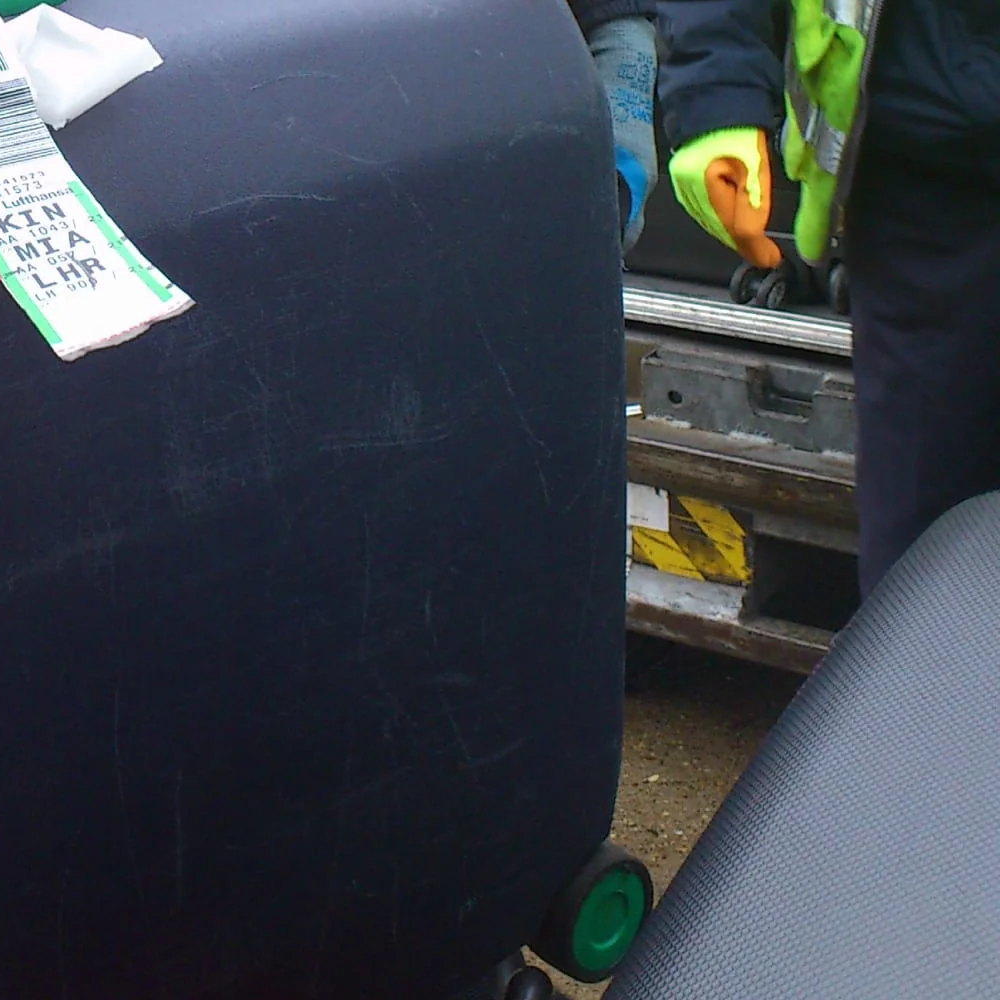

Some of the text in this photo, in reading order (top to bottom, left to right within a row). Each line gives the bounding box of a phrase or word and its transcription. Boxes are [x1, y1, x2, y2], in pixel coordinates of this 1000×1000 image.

[2, 186, 74, 209] Lufthansa
[13, 230, 91, 262] MIA
[32, 257, 106, 289] LHR
